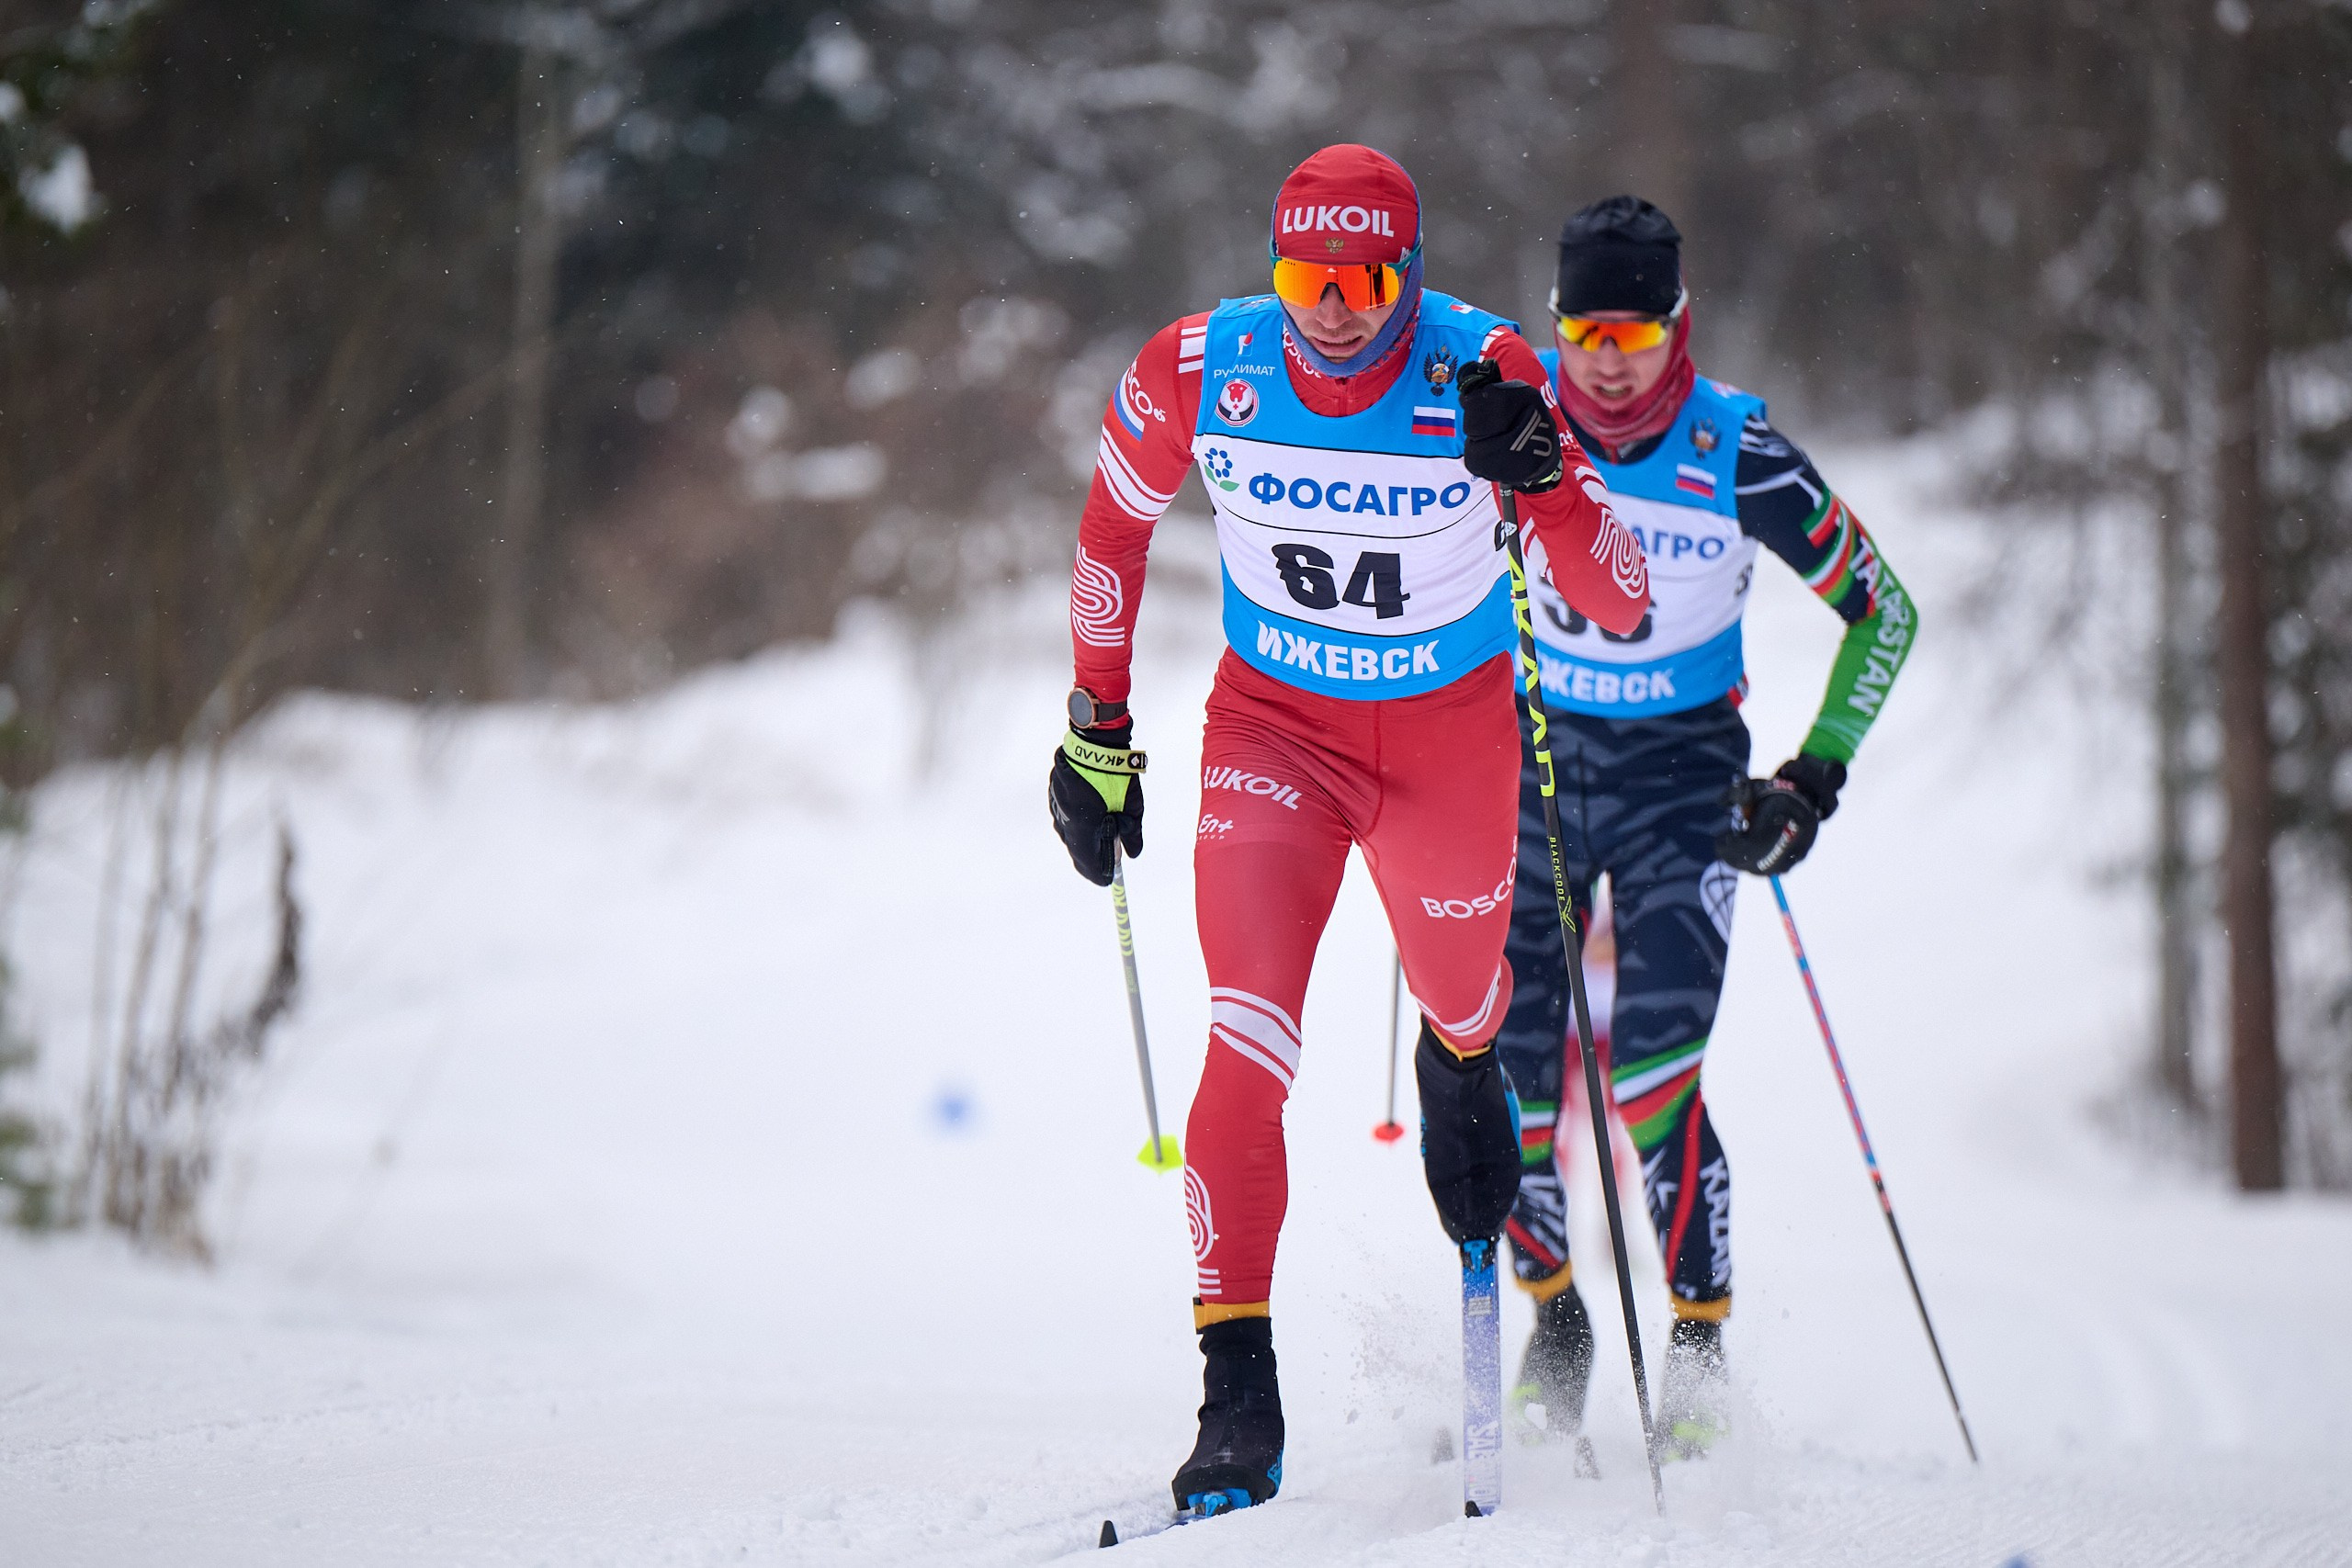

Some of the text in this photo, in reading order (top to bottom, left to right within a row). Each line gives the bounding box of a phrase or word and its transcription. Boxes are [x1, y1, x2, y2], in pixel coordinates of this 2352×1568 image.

[1282, 205, 1395, 237] LUKOIL
[1249, 472, 1471, 516] ФОСАГРО
[1272, 543, 1409, 619] 64
[1257, 620, 1440, 681] ИЖЕВСК
[1420, 855, 1517, 919] BOSCO
[1549, 837, 1566, 901] BLACKCODE
